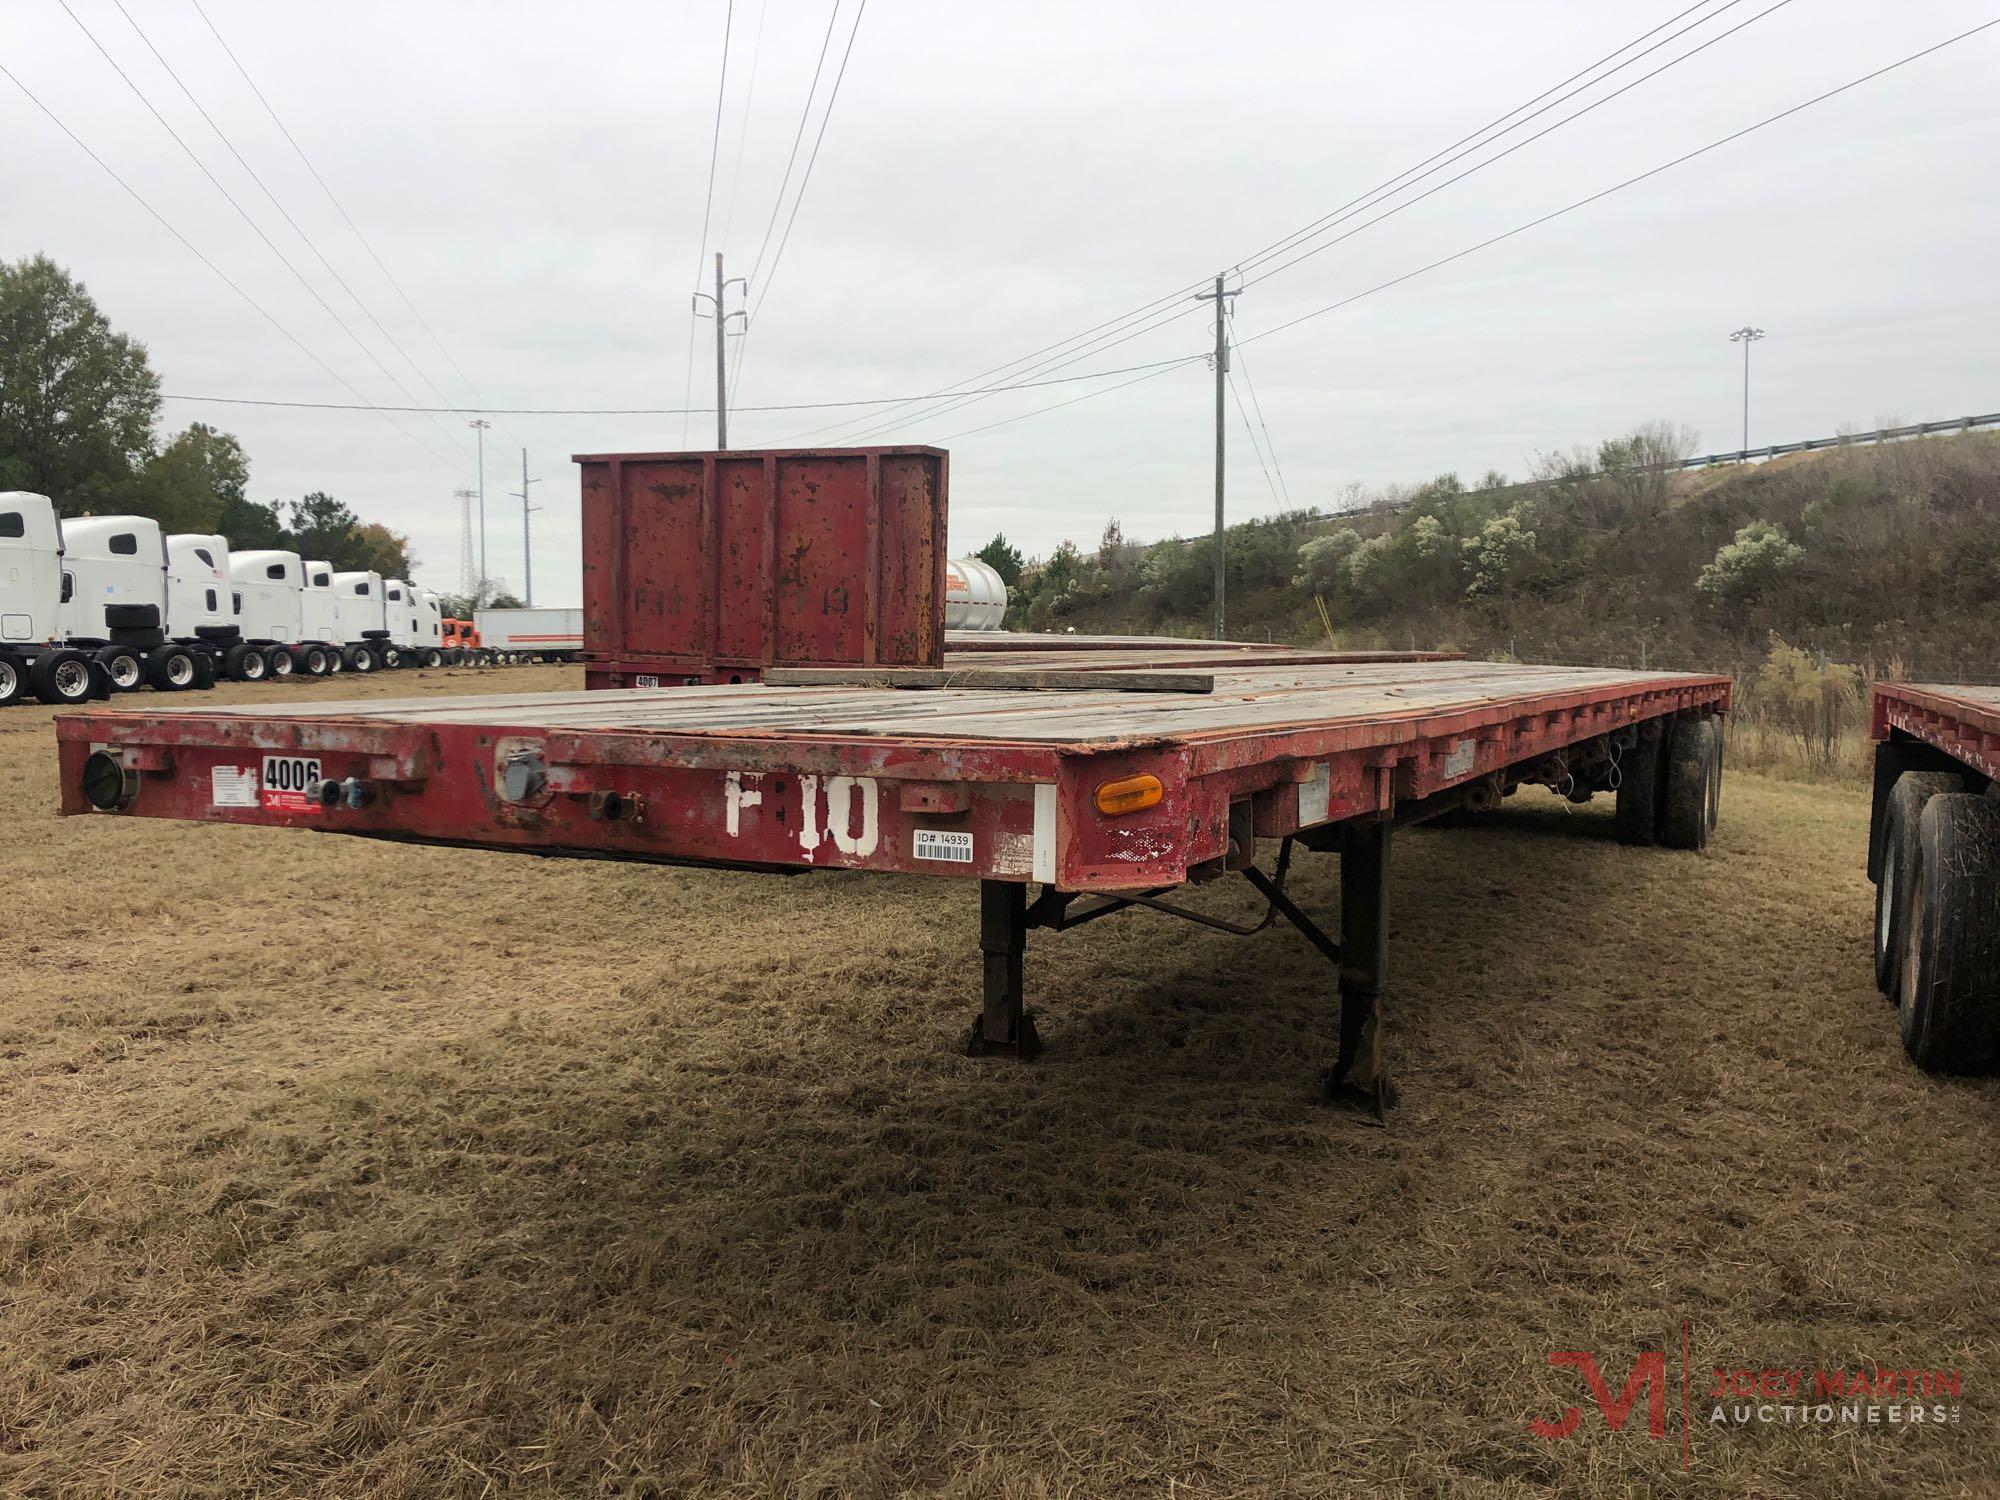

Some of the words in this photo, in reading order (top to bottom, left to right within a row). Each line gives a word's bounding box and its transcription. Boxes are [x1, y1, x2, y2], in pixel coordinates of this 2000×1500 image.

[638, 676, 657, 688] 4007
[265, 759, 319, 791] 4006
[918, 833, 936, 843] ID#
[941, 834, 969, 846] 14939
